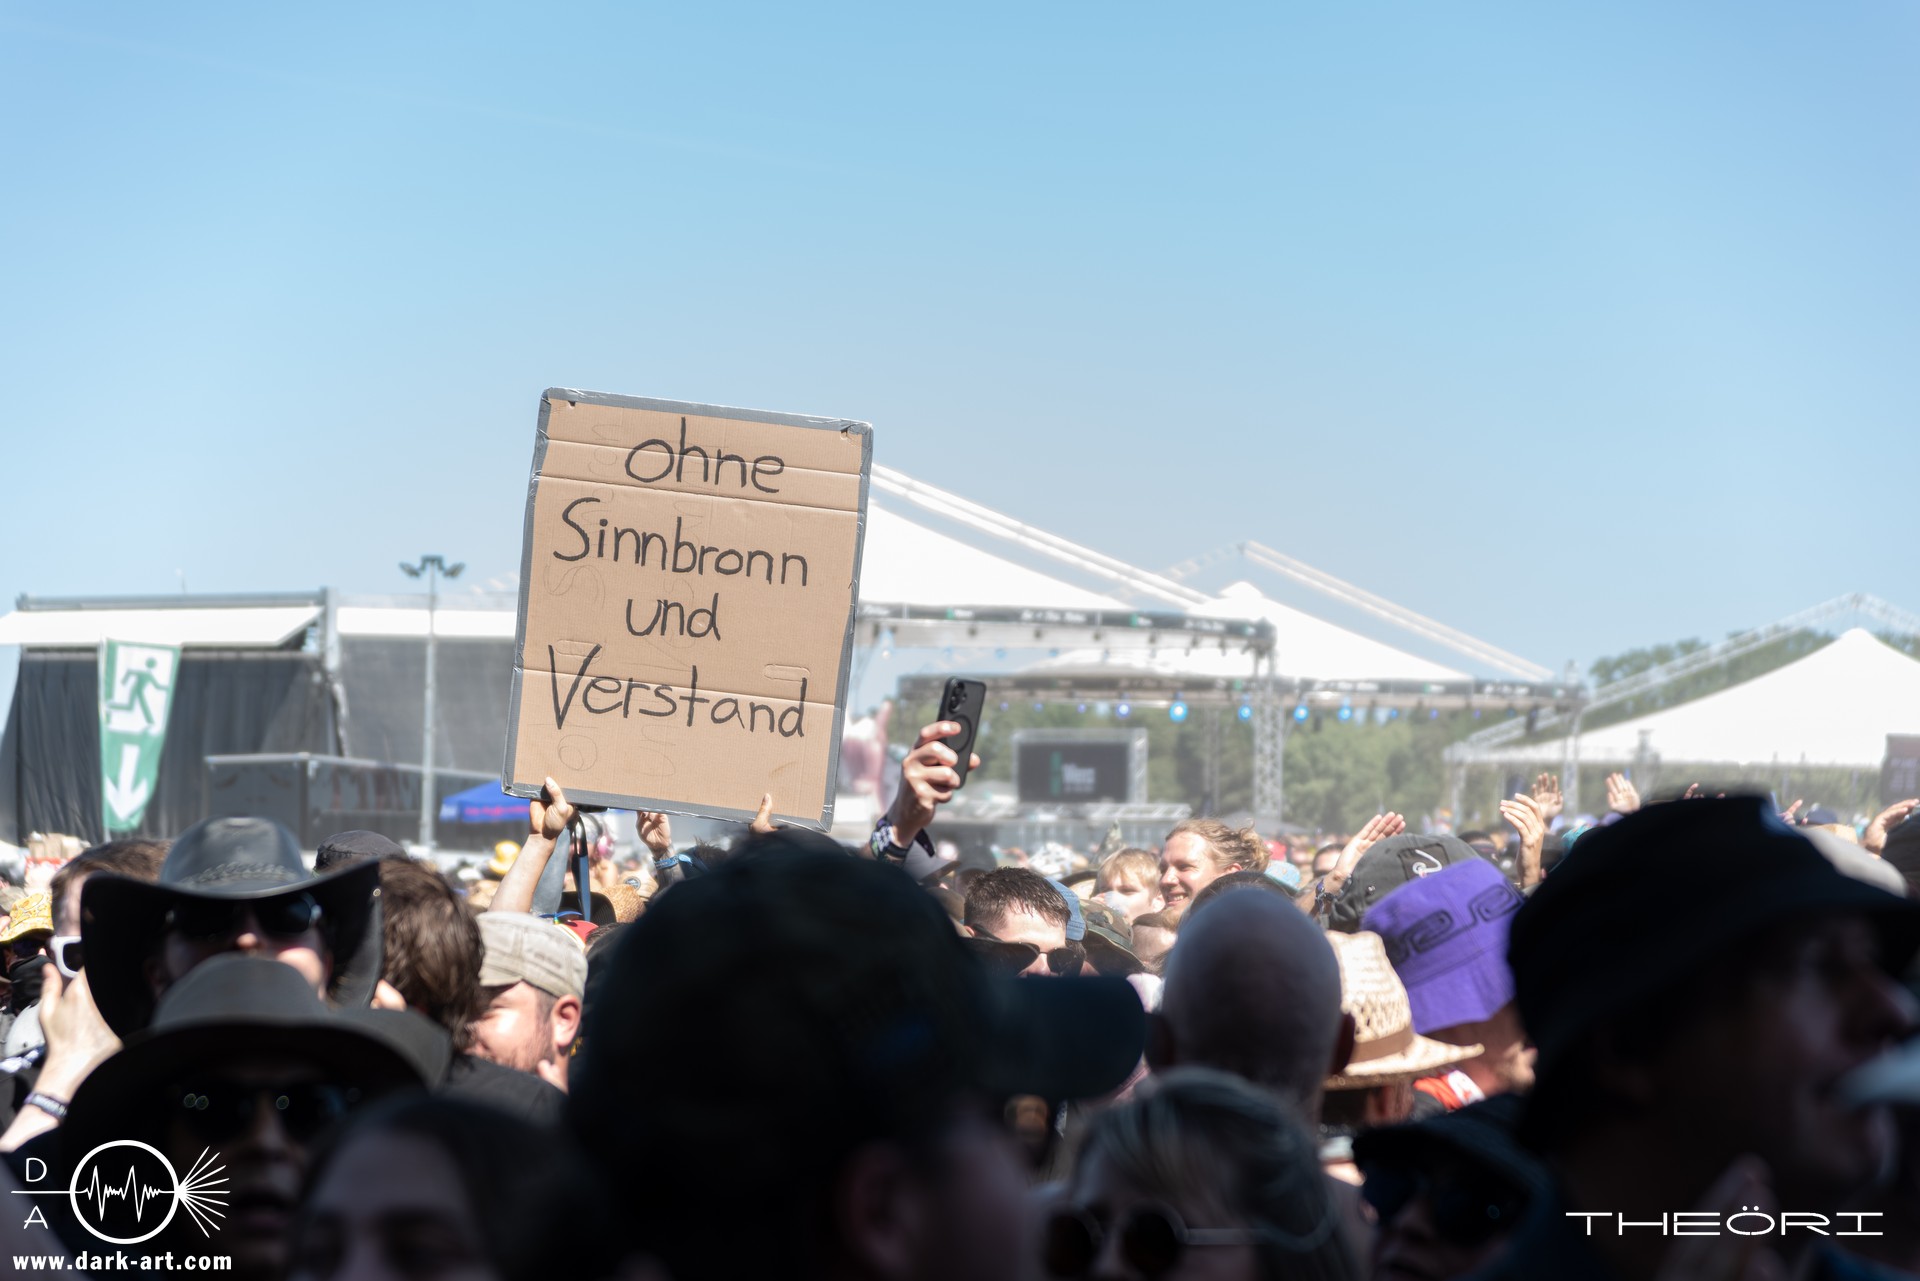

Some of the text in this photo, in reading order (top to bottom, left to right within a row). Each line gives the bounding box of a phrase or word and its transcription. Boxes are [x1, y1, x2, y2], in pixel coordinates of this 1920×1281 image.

[553, 497, 808, 587] Sinnbronn
[625, 592, 721, 641] und
[548, 644, 808, 738] Verstand
